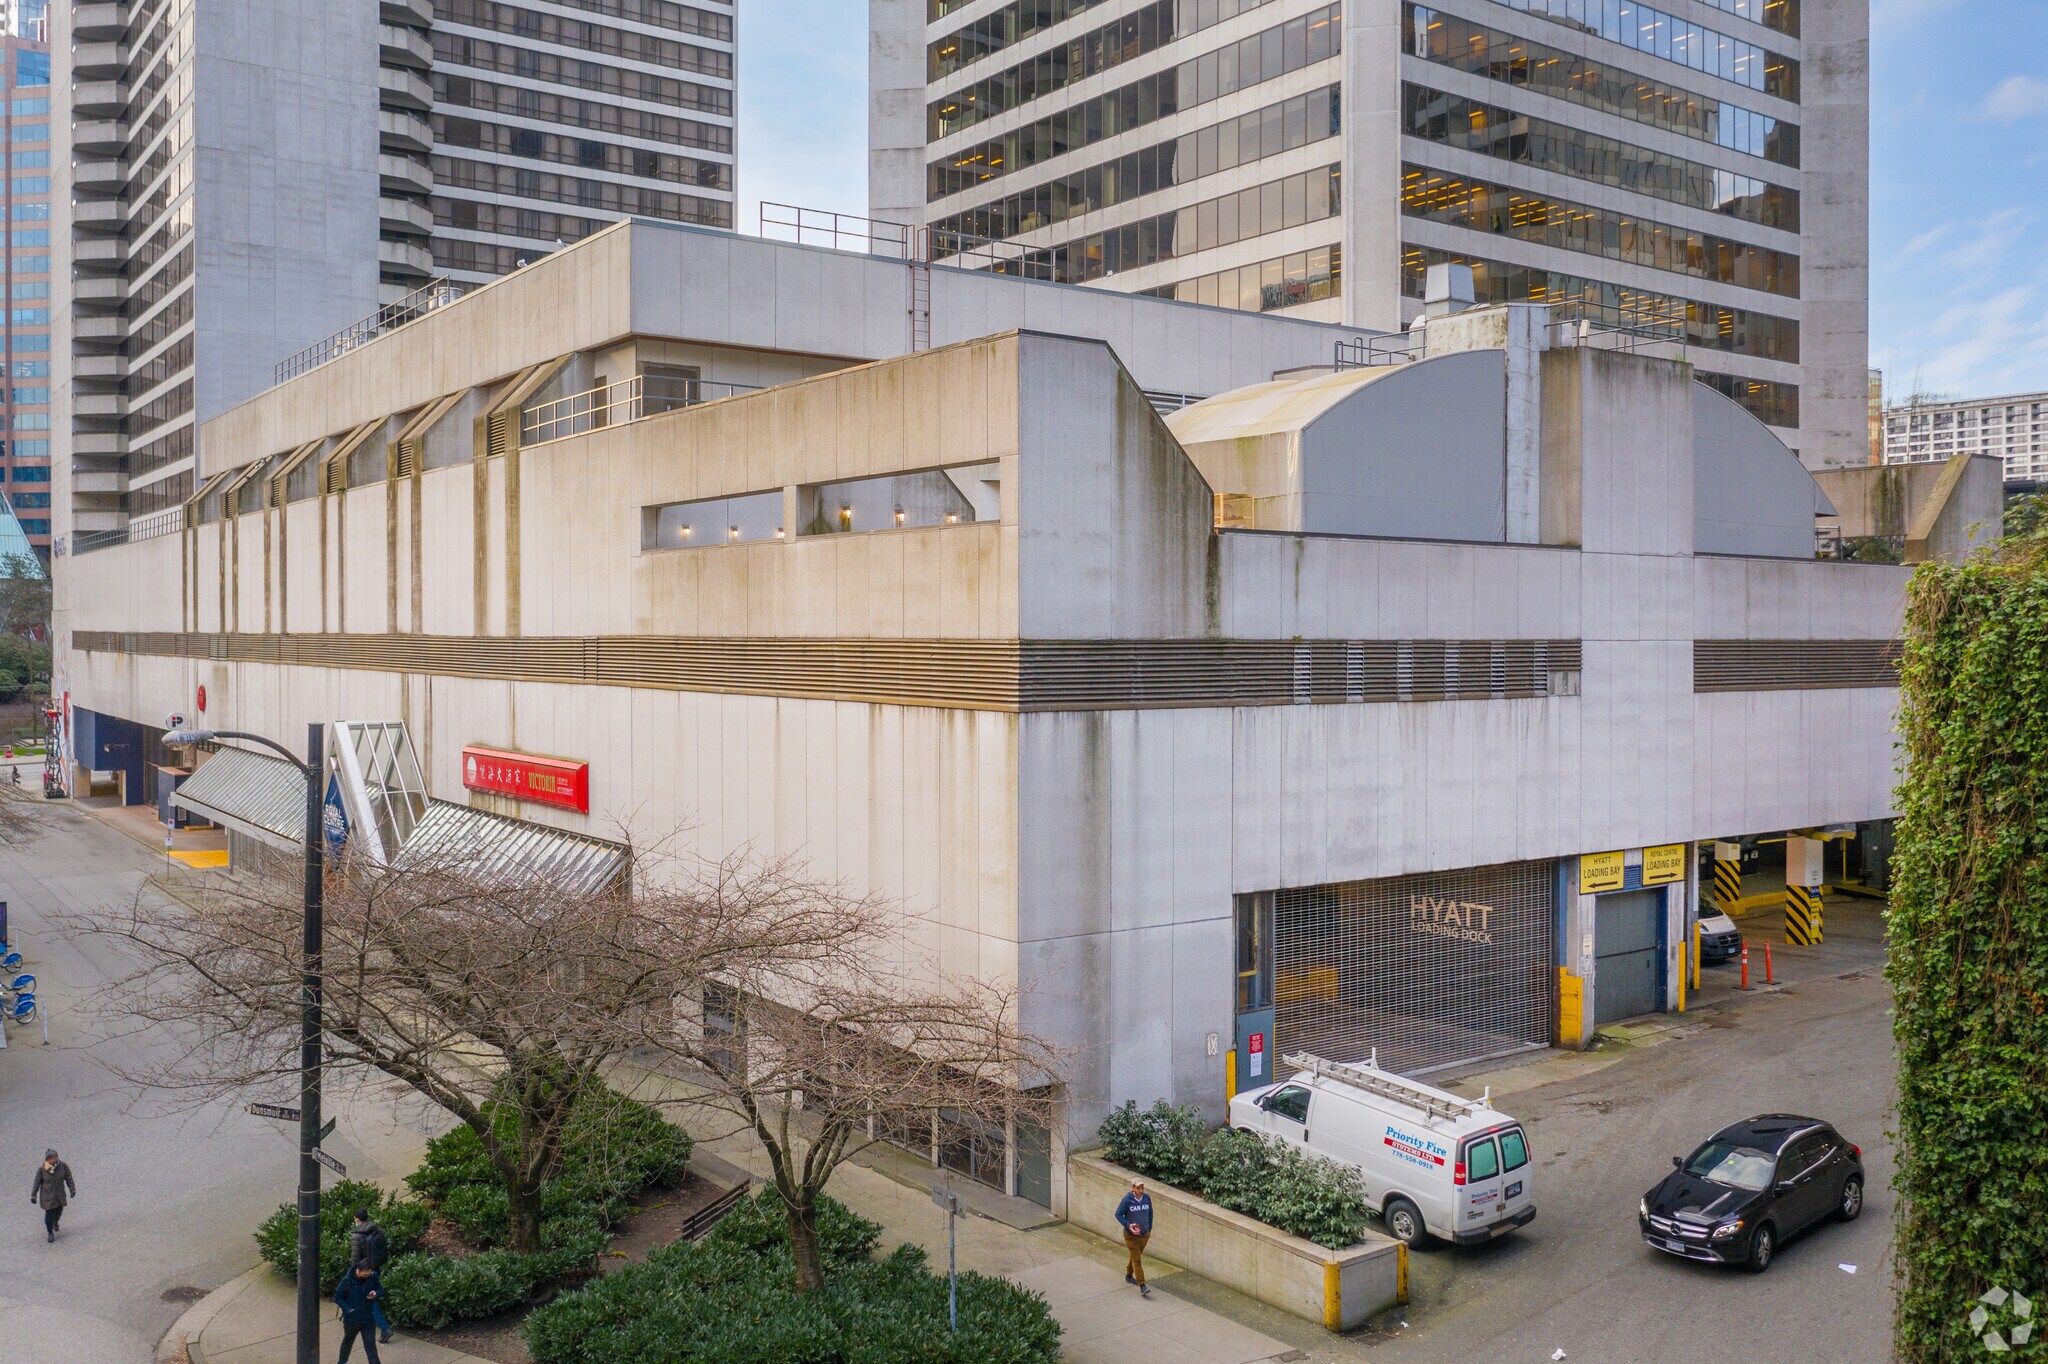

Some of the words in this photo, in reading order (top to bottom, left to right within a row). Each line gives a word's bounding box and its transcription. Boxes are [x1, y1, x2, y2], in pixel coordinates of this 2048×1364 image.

[528, 772, 556, 792] VICTORIA
[1594, 856, 1611, 864] HYATT
[1646, 860, 1670, 870] LOADING
[1671, 858, 1682, 867] BAY
[1583, 867, 1609, 878] LOADING
[1610, 865, 1621, 876] BAY
[1411, 895, 1493, 930] HYATT
[1411, 920, 1459, 938] LOADING
[1462, 929, 1492, 944] DOCK
[252, 1104, 281, 1118] Dunsmuir
[1385, 1126, 1424, 1149] Priority
[1426, 1141, 1447, 1156] Fire
[1392, 1141, 1421, 1157] SYSTEMS
